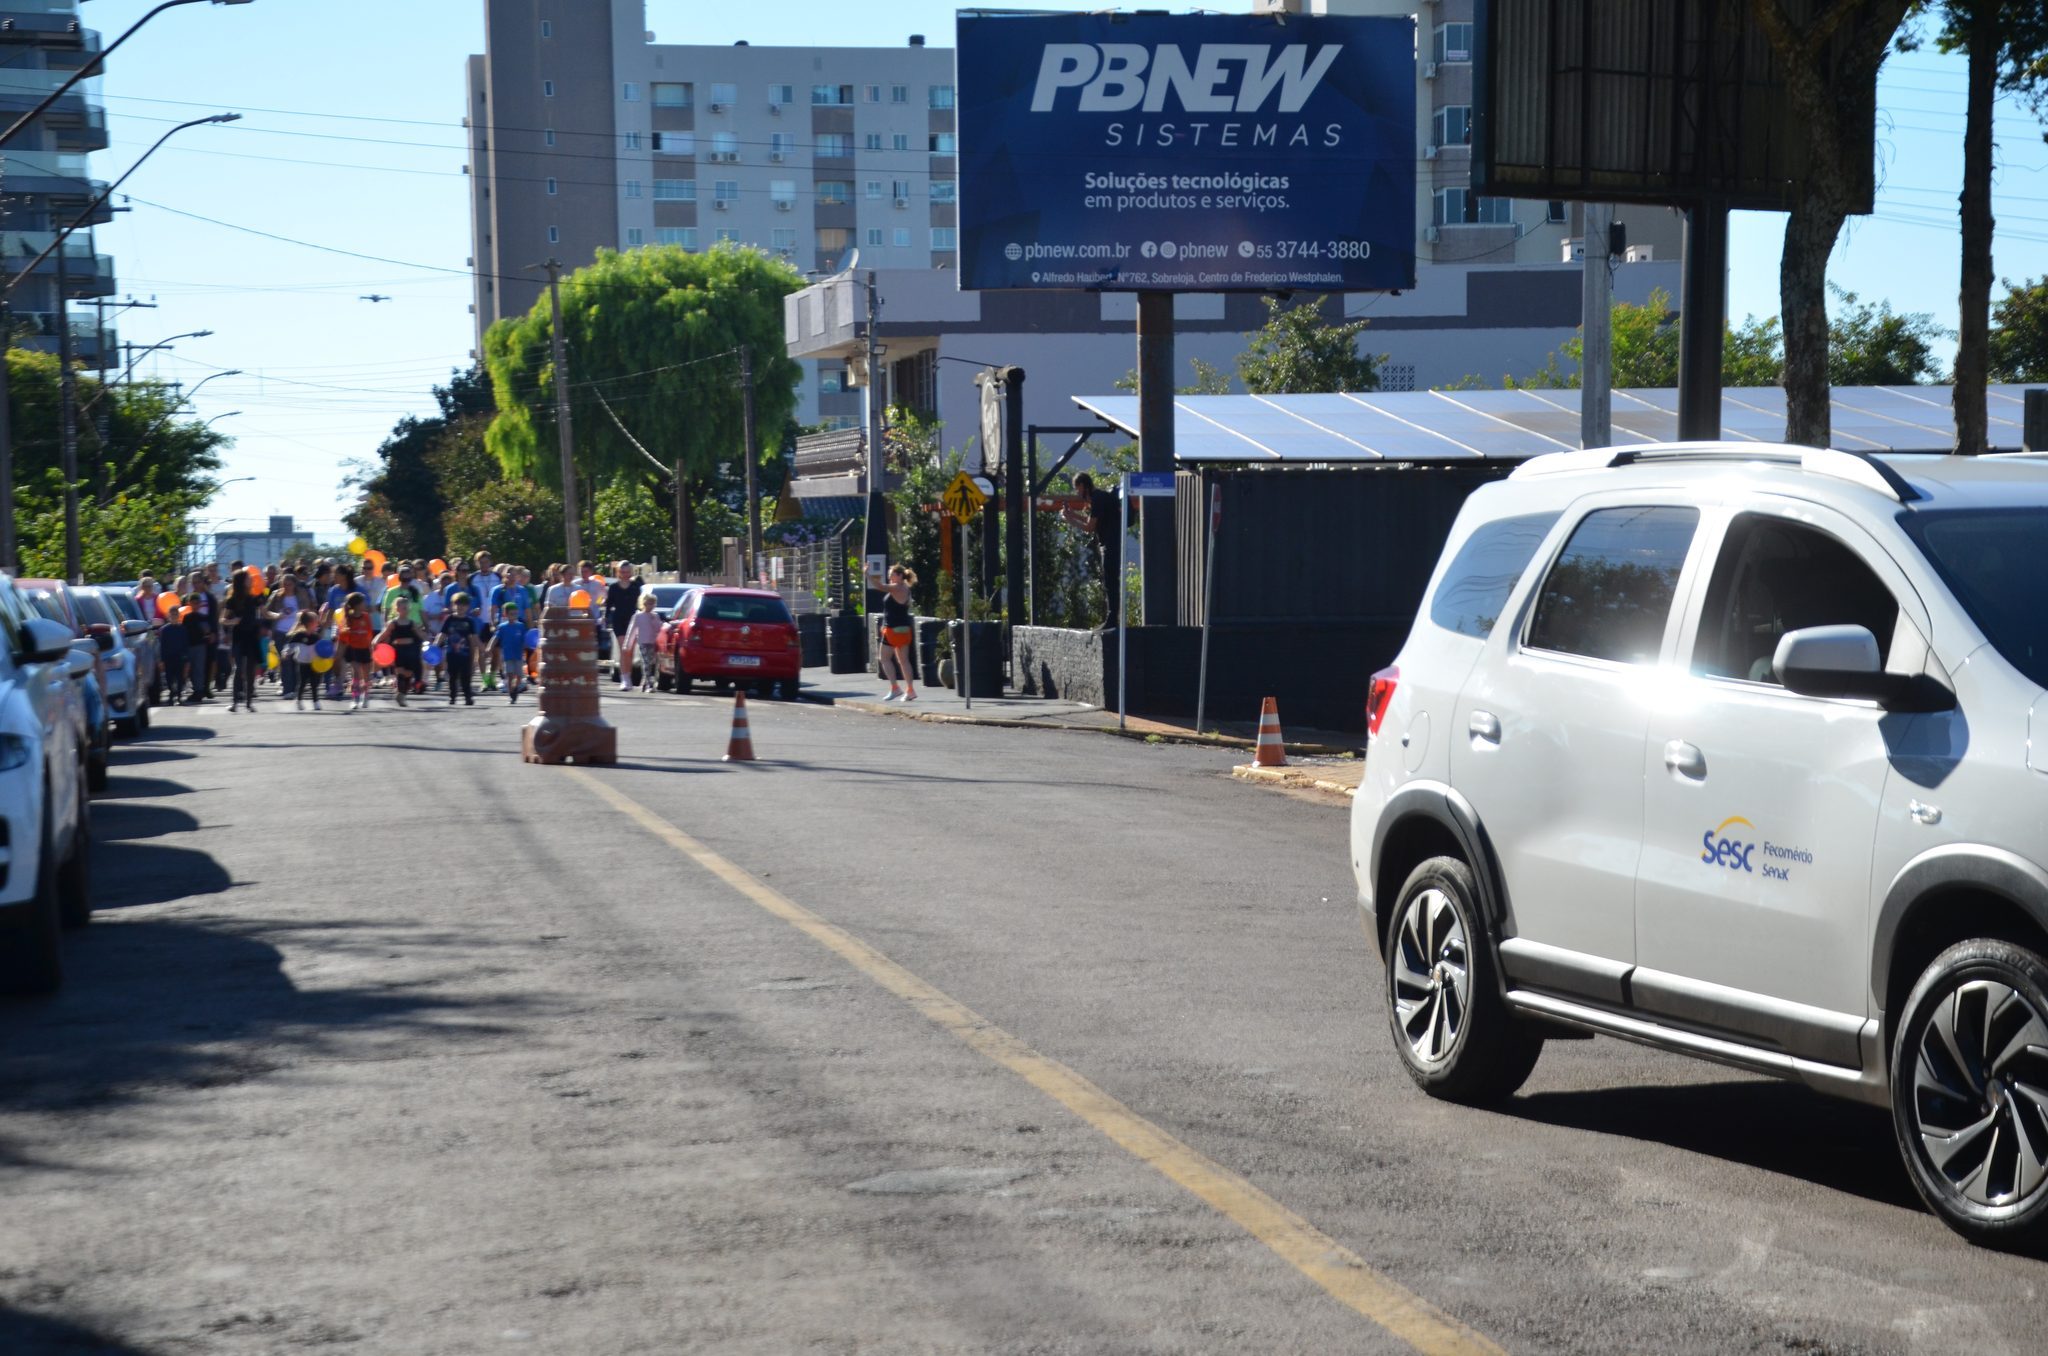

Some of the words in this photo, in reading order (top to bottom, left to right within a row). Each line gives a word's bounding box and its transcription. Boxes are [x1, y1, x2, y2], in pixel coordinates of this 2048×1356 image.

[1030, 43, 1344, 112] PBNEW
[1105, 123, 1343, 146] SISTEMAS
[1085, 172, 1167, 192] Soluções
[1172, 172, 1289, 192] tecnológicas
[1084, 194, 1112, 208] em
[1117, 191, 1196, 211] produtos
[1200, 195, 1211, 207] e
[1216, 191, 1290, 212] serviços.
[1025, 242, 1131, 261] pbnew.com.br
[1180, 242, 1229, 260] pbnew
[1256, 245, 1272, 259] 55
[1277, 241, 1370, 259] 3744-3880
[1042, 272, 1075, 283] Alfredo
[1152, 272, 1197, 285] Sobreloja,
[1199, 272, 1229, 283] Centro
[1231, 272, 1243, 283] de
[1245, 272, 1288, 283] Frederico
[1289, 272, 1344, 284] Westphalen.
[1763, 841, 1813, 864] Fecomércio
